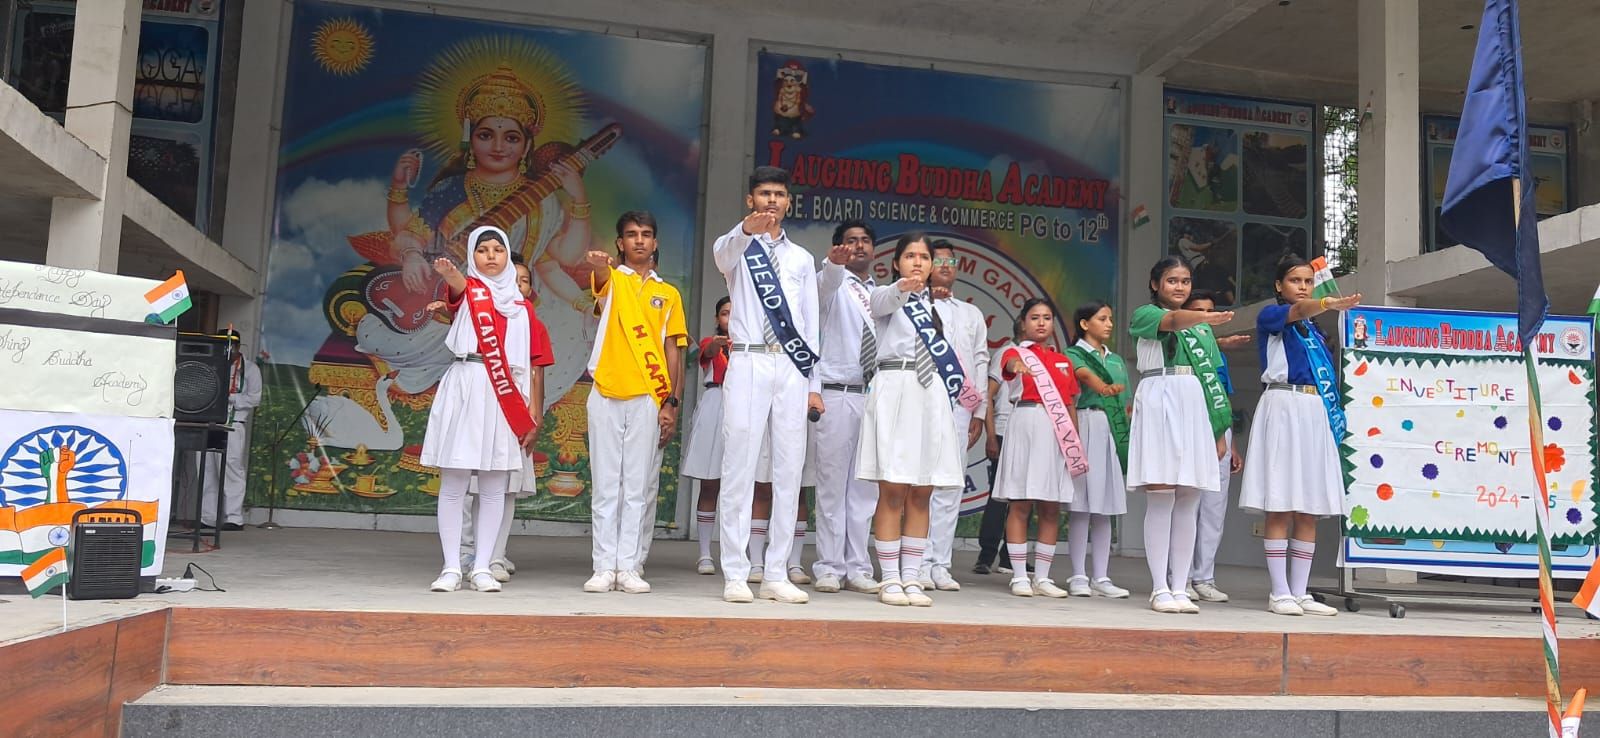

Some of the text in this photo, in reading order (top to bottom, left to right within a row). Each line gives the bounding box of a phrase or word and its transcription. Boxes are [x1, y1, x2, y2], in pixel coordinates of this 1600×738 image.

[139, 48, 201, 82] OGA
[768, 140, 1109, 209] LAUGHING BUDDHA ACADEMY
[813, 195, 863, 221] BOARD
[869, 201, 926, 223] SCIENCE
[929, 206, 938, 223] &
[941, 207, 1015, 229] COMMERCE
[1019, 213, 1048, 239] PG
[1053, 216, 1072, 240] to
[0, 280, 112, 318] dependance Day
[746, 253, 815, 370] HEAD BOY
[904, 301, 949, 356] HEAD
[1374, 319, 1439, 349] LAUGHING
[1440, 322, 1492, 350] BUDDHA
[1494, 325, 1556, 353] ACAMY
[42, 349, 93, 366] Buddha
[477, 311, 513, 395] CAPTAIN
[1025, 355, 1068, 432] CULTURAL
[1386, 378, 1515, 401] INVESTITURE
[1435, 440, 1518, 466] CEREMONY
[1476, 485, 1557, 509] 2024-5
